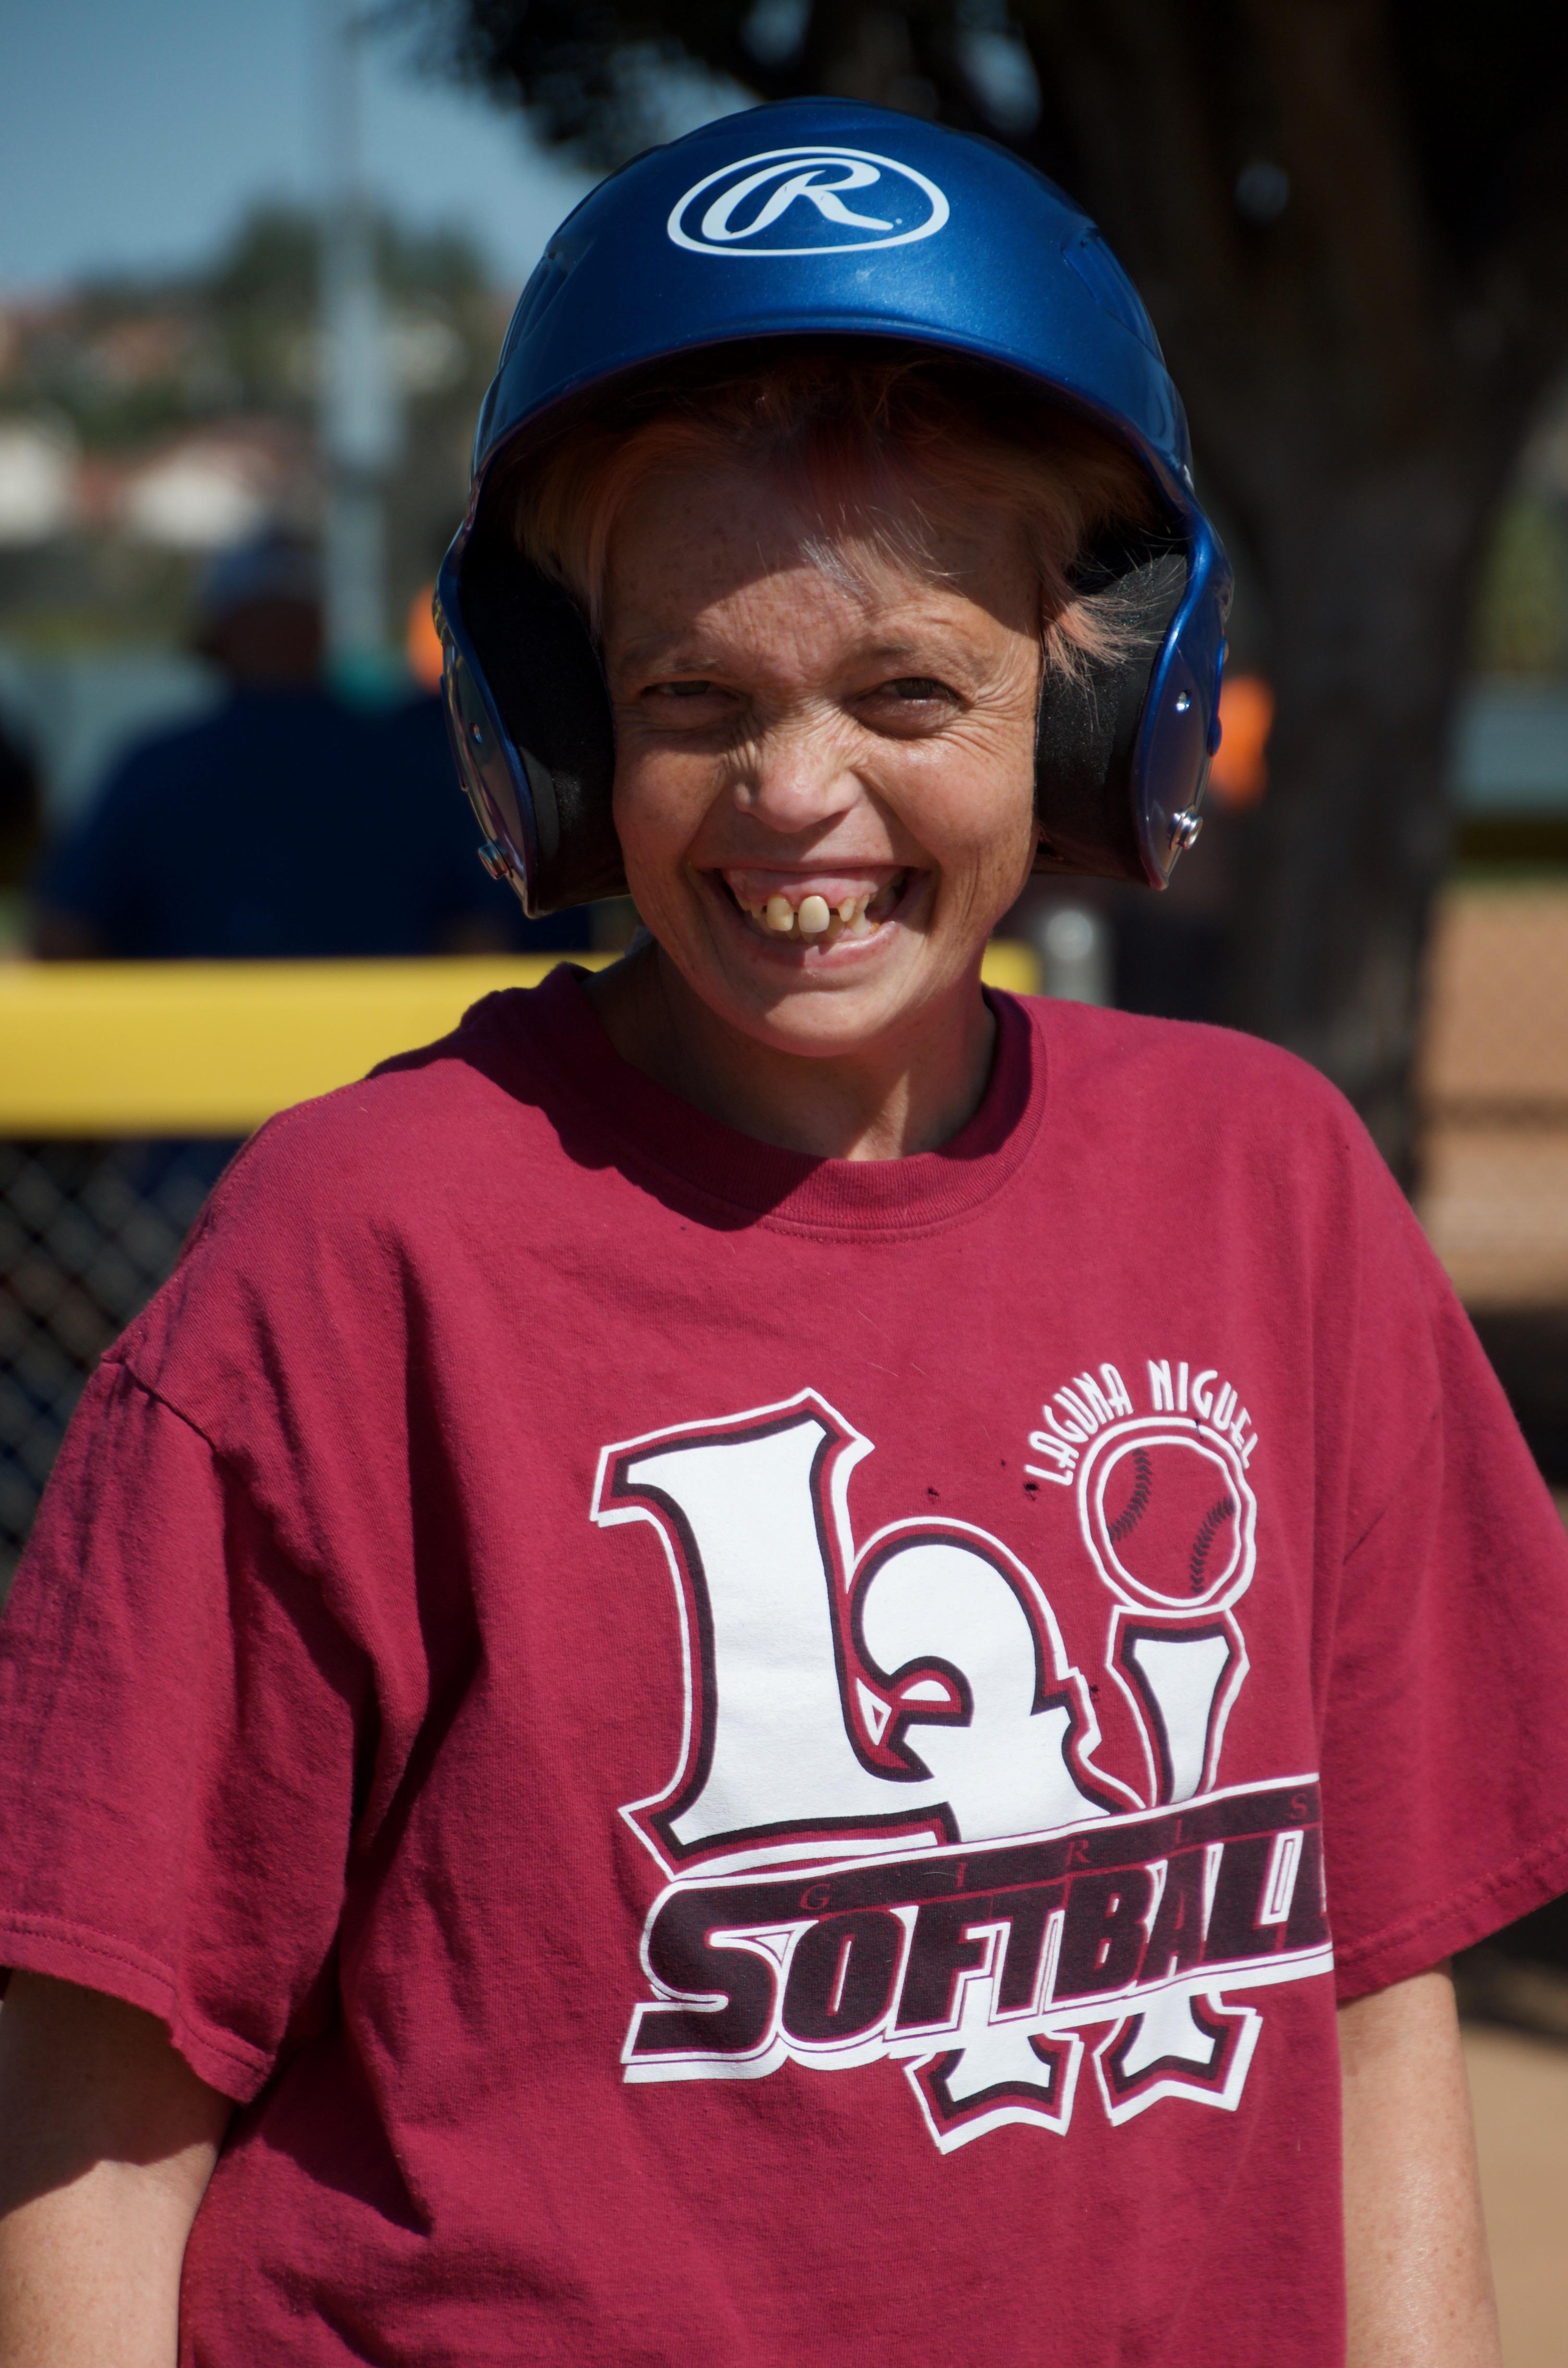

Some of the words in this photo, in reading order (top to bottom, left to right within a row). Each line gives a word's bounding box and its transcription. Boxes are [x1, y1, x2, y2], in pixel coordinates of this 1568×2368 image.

[701, 157, 894, 241] R
[1024, 1363, 1134, 1486] LAGUNA
[1147, 1359, 1259, 1469] NIGUEL
[799, 1793, 1308, 1911] GIRLS
